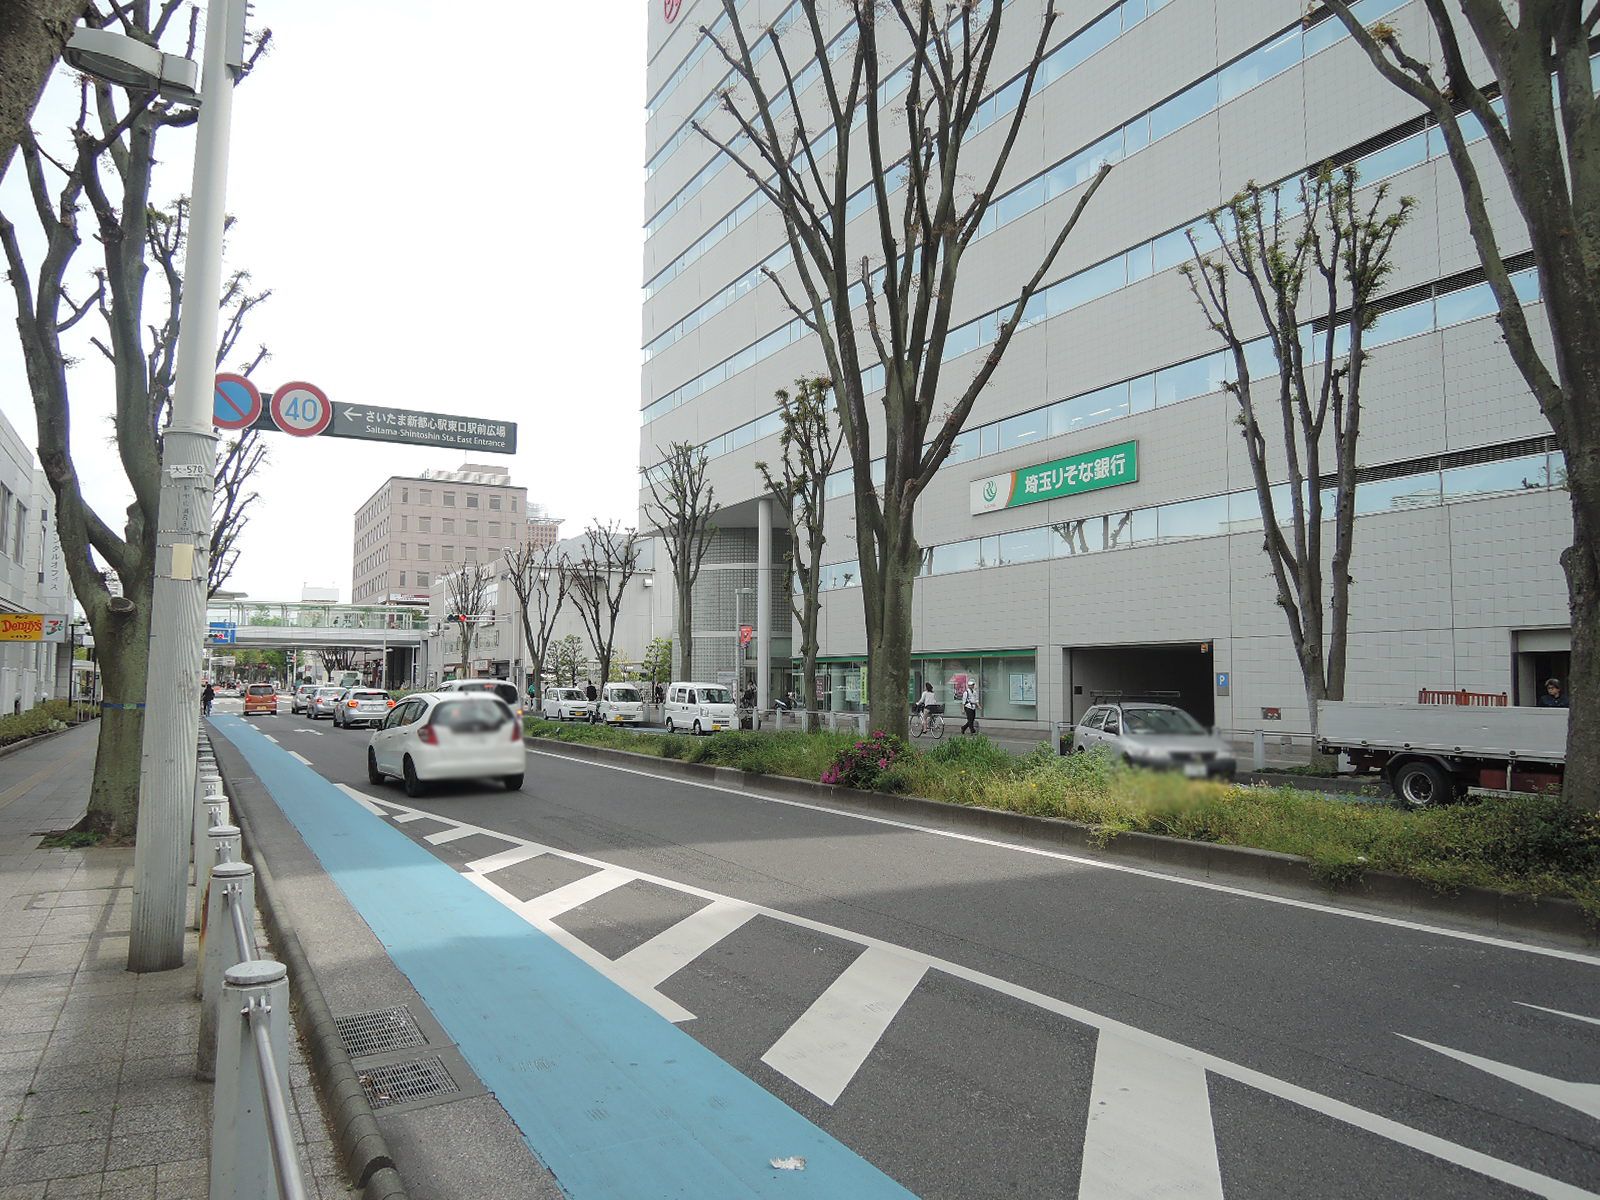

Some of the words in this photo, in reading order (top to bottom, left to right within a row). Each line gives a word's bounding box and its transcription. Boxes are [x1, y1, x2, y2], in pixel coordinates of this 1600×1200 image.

[284, 396, 318, 422] 40
[365, 410, 506, 438] さいたま新都心駅東口駅前広場
[365, 425, 441, 441] Saitama-Shintoshin
[441, 434, 456, 442] Sta.
[456, 435, 473, 445] East
[473, 437, 506, 448] Entrance
[1024, 453, 1126, 494] 埼玉りそな銀行
[2, 619, 42, 633] Denny's
[1219, 675, 1225, 686] P
